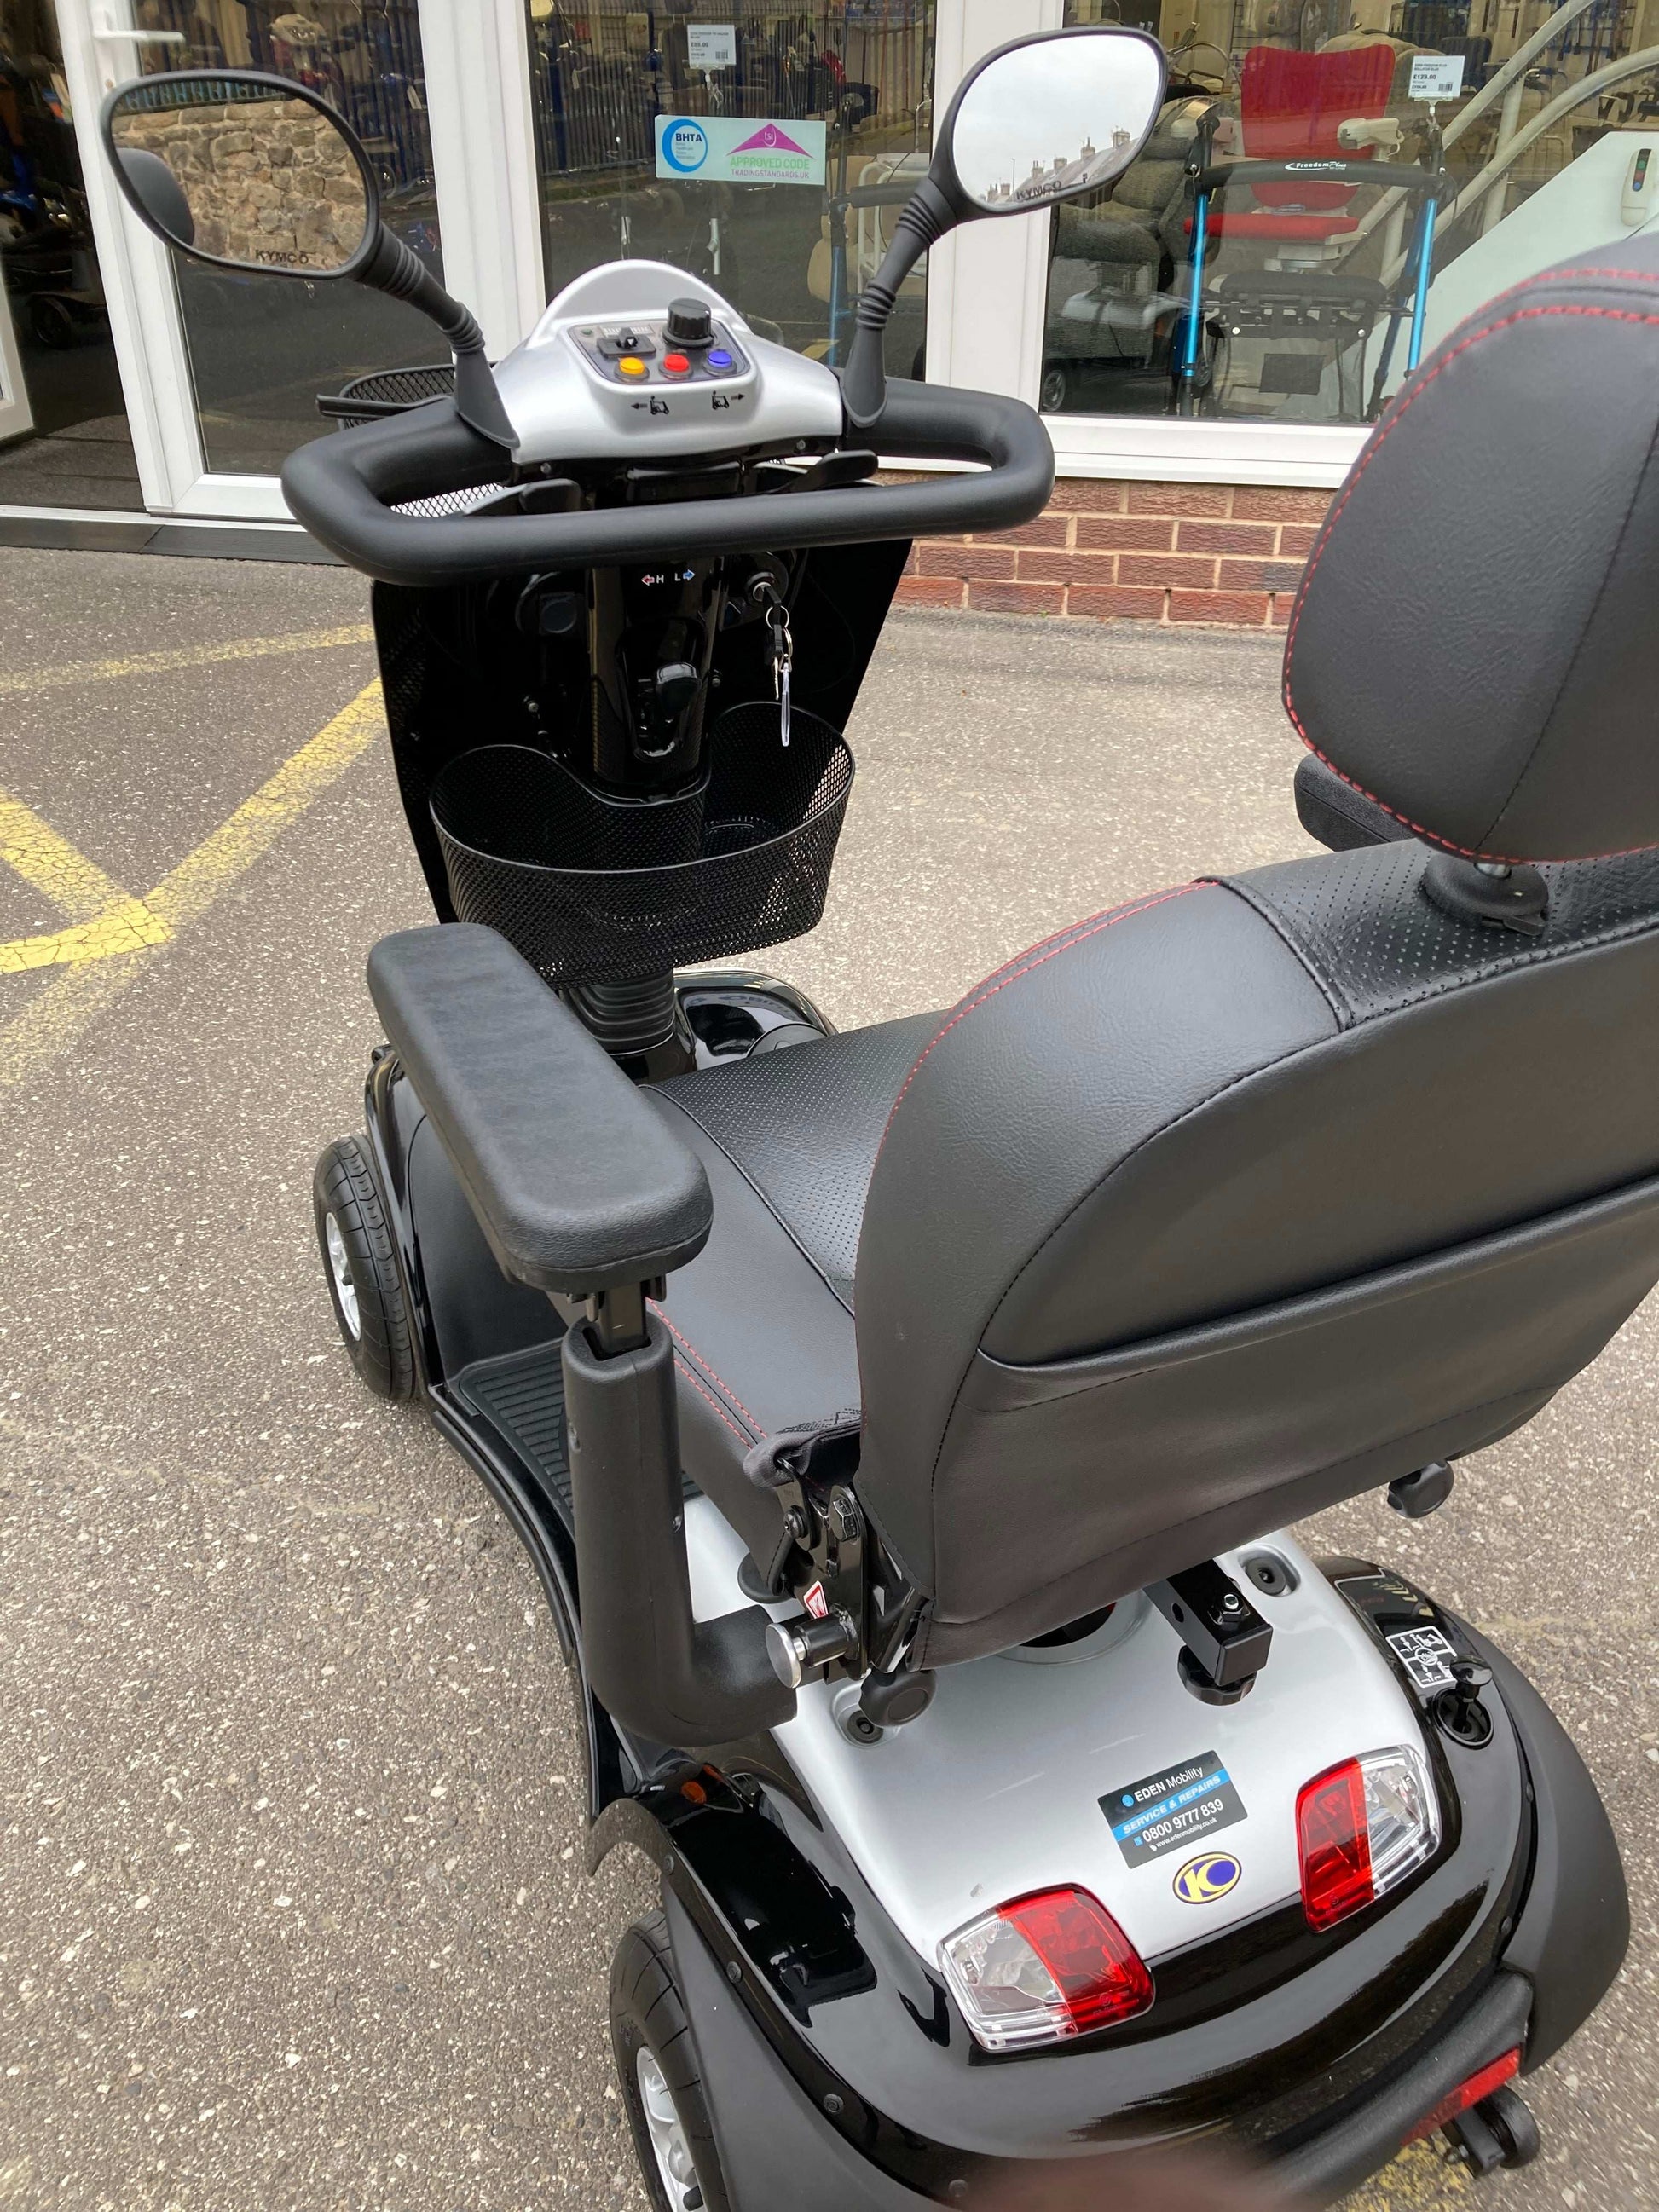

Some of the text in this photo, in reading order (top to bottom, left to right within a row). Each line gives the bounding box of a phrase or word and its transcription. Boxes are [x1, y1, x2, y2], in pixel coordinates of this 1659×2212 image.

[675, 133, 702, 142] BHTA
[730, 156, 811, 170] APPROVED CODE
[731, 169, 810, 179] TRADINGSTANDARDS.UK
[255, 248, 309, 265] KYMCO
[656, 574, 664, 584] H
[674, 572, 681, 581] L
[1135, 1767, 1204, 1803] EDEN Mobility
[1122, 1775, 1222, 1834] SERVICE & REPAIRS
[1142, 1798, 1224, 1843] 0800 9777 839
[1156, 1816, 1217, 1848] www.edenmobility.co.uk
